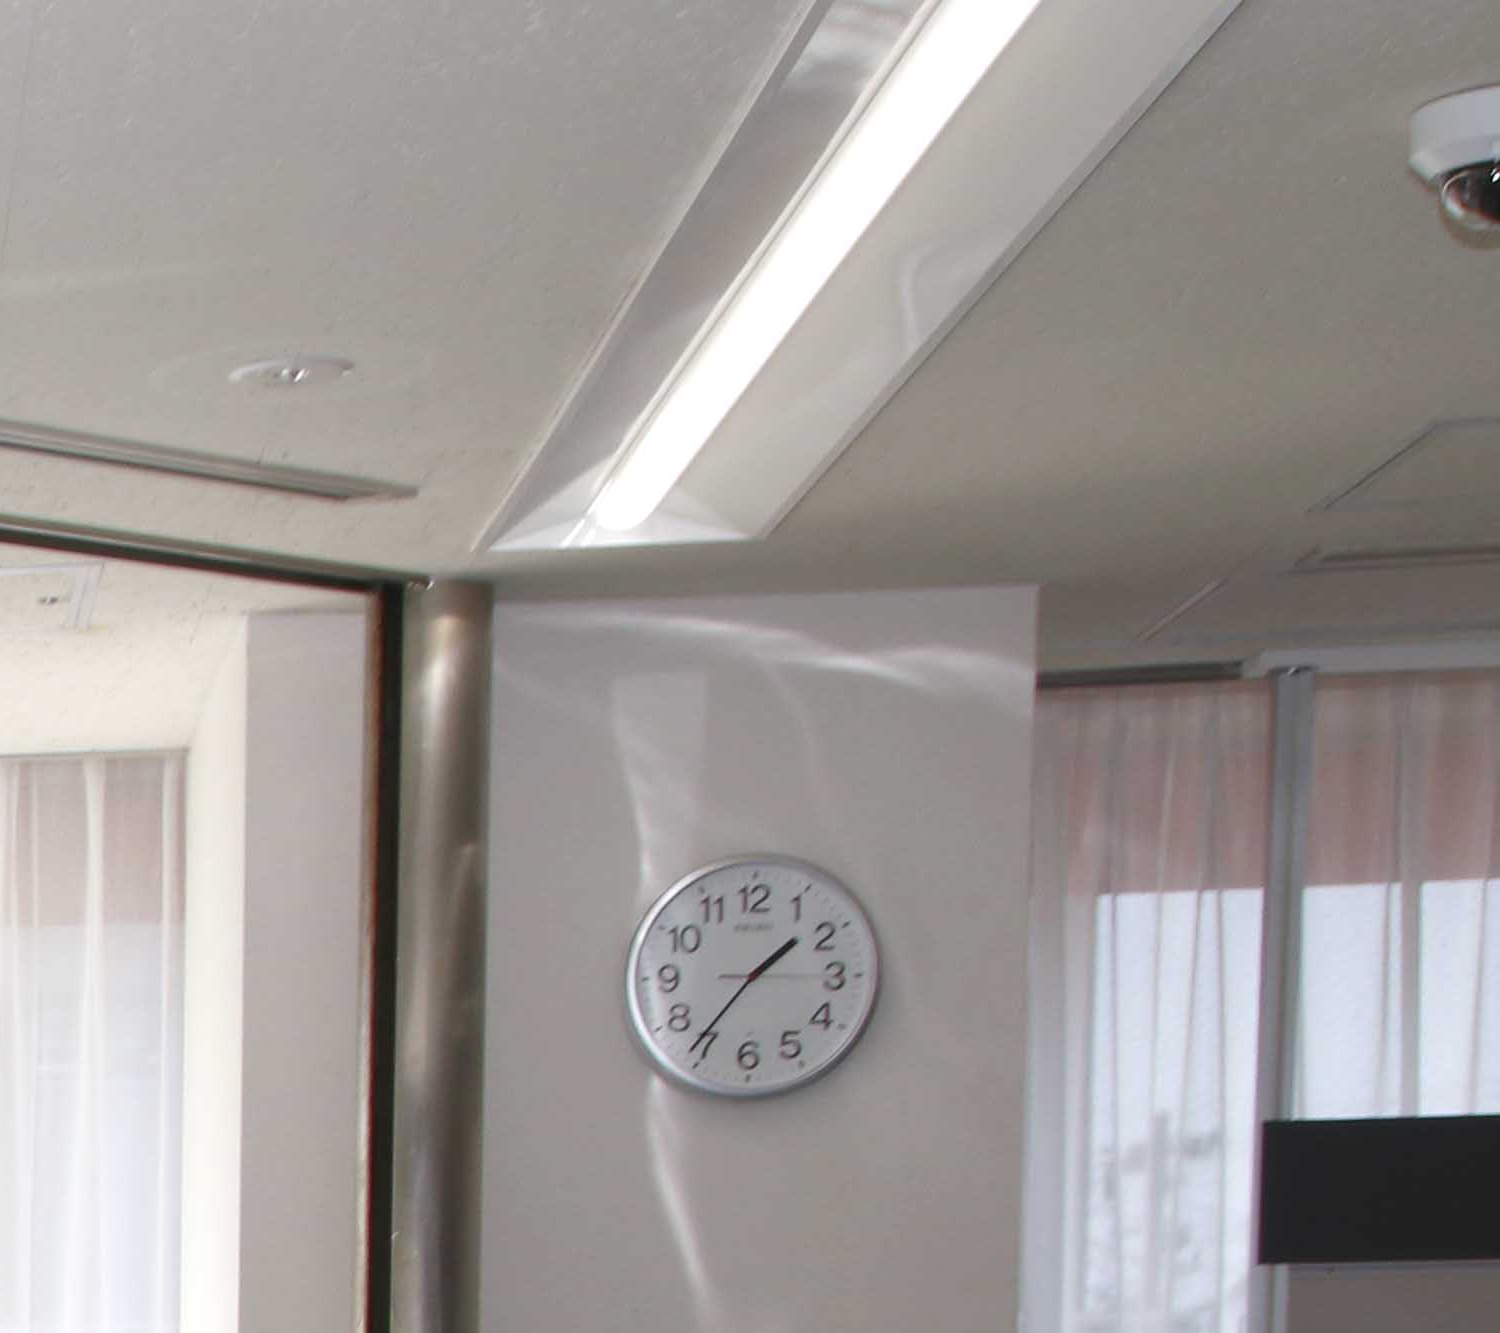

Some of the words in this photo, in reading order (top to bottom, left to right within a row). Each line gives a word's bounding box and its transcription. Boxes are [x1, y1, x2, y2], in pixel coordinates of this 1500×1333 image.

[700, 895, 724, 923] 11
[737, 883, 772, 914] 12
[790, 895, 801, 921] 1
[668, 923, 701, 954] 10
[814, 921, 836, 951] 2
[657, 963, 680, 993] 9
[823, 961, 846, 991] 3
[667, 1003, 691, 1032] 8
[809, 1002, 833, 1031] 4
[699, 1031, 719, 1059] 7
[737, 1041, 760, 1070] 6
[780, 1030, 801, 1059] 5
